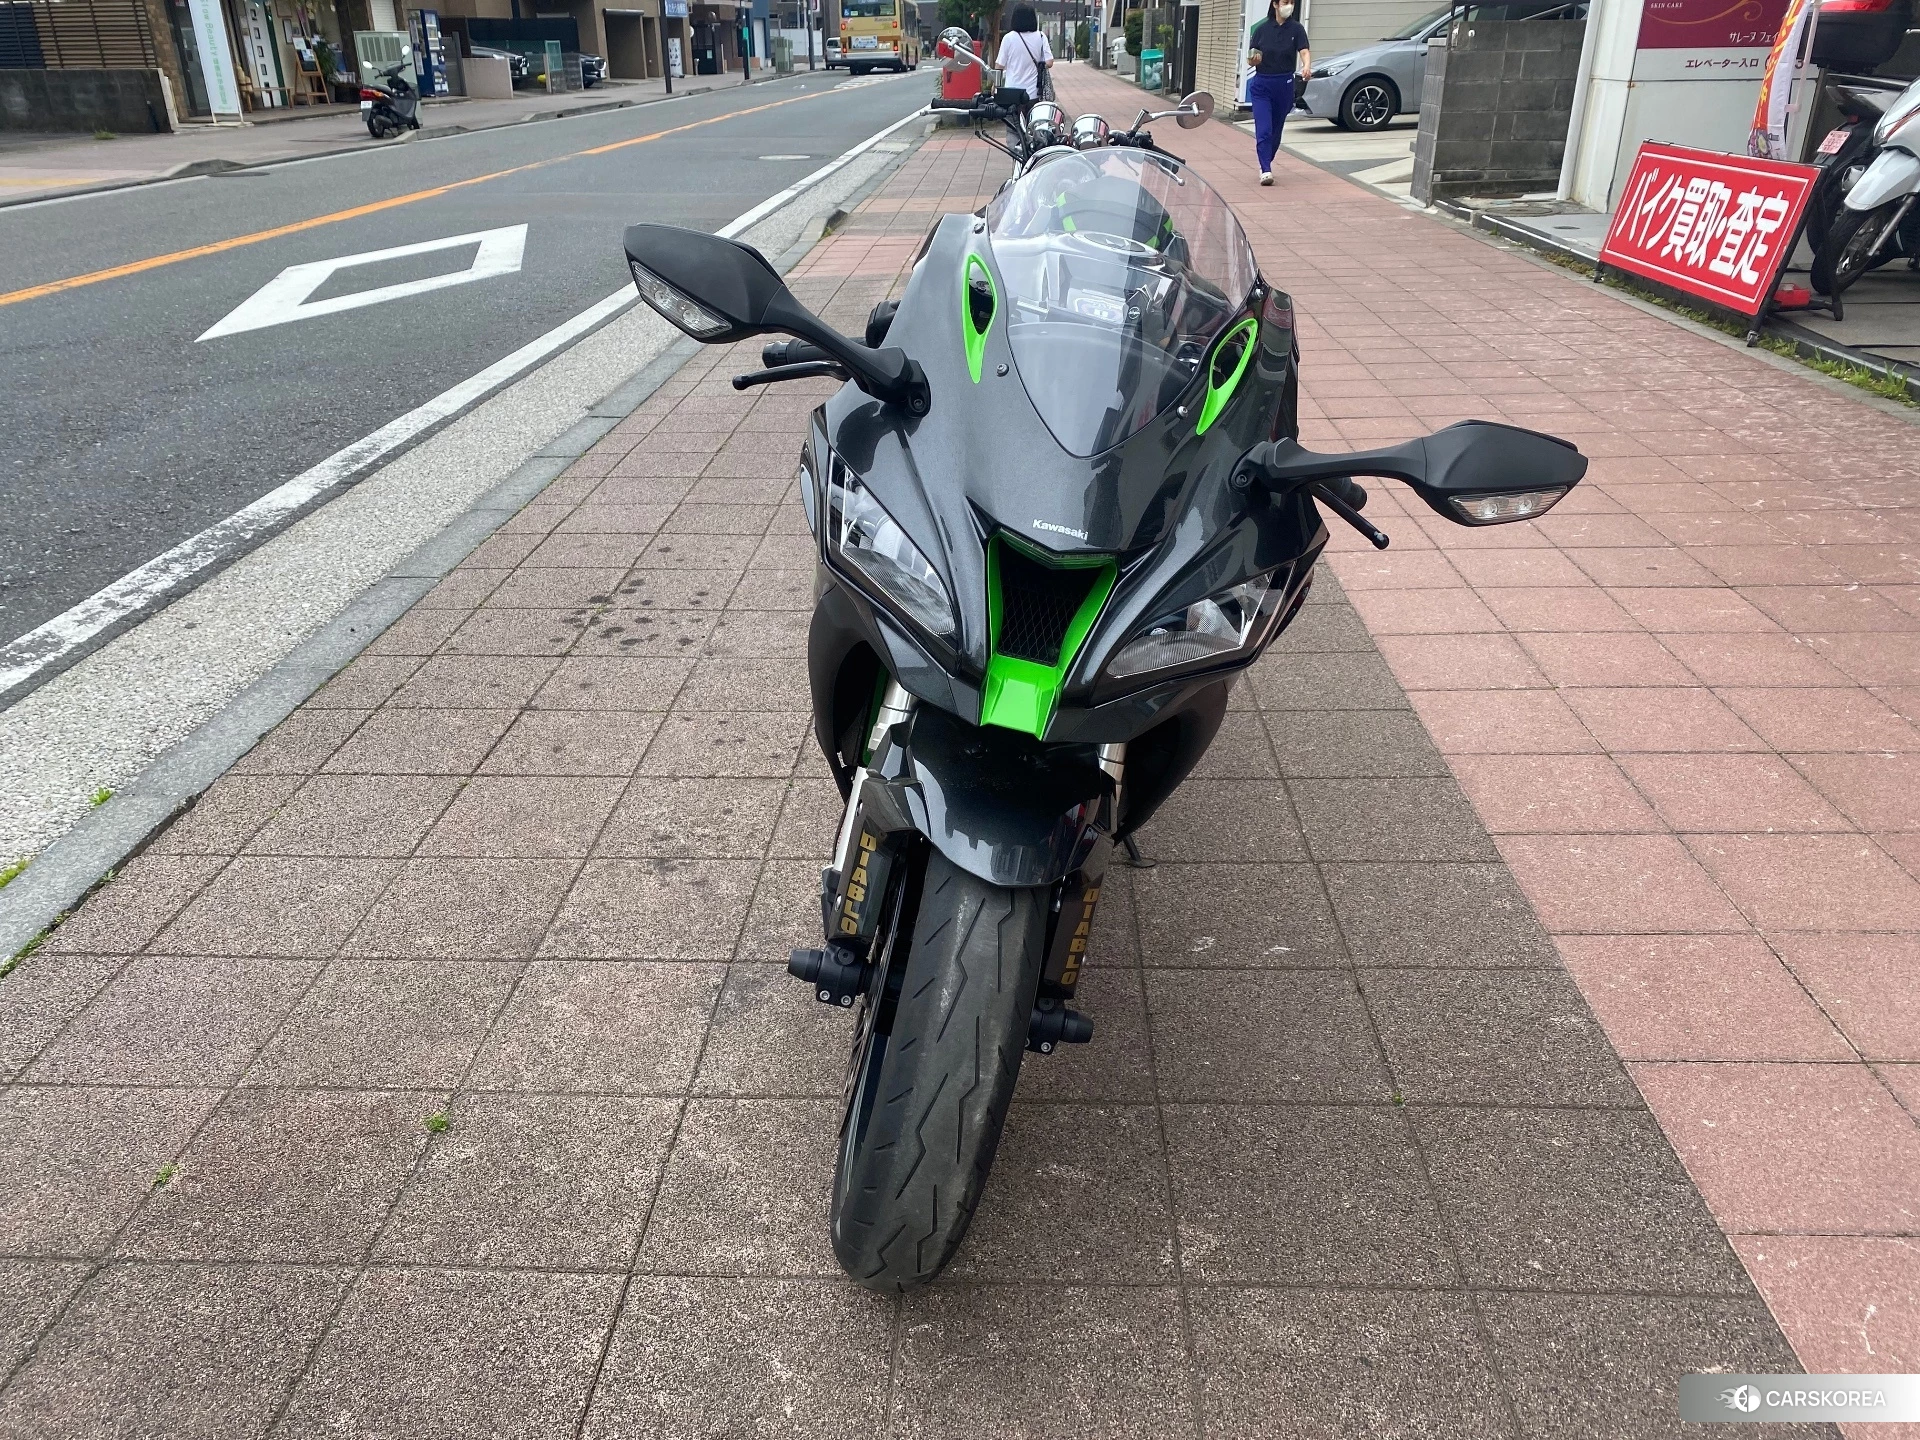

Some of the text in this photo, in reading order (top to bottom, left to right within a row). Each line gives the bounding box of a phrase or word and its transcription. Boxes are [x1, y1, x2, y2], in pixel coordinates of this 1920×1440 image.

[1685, 58, 1759, 68] エレベーター入口
[1729, 31, 1757, 43] サレーヌ
[1616, 167, 1790, 286] バイク買取・査定
[1032, 518, 1089, 541] Kawasaki
[840, 831, 877, 935] DIABLO
[1060, 887, 1100, 986] DIABLO
